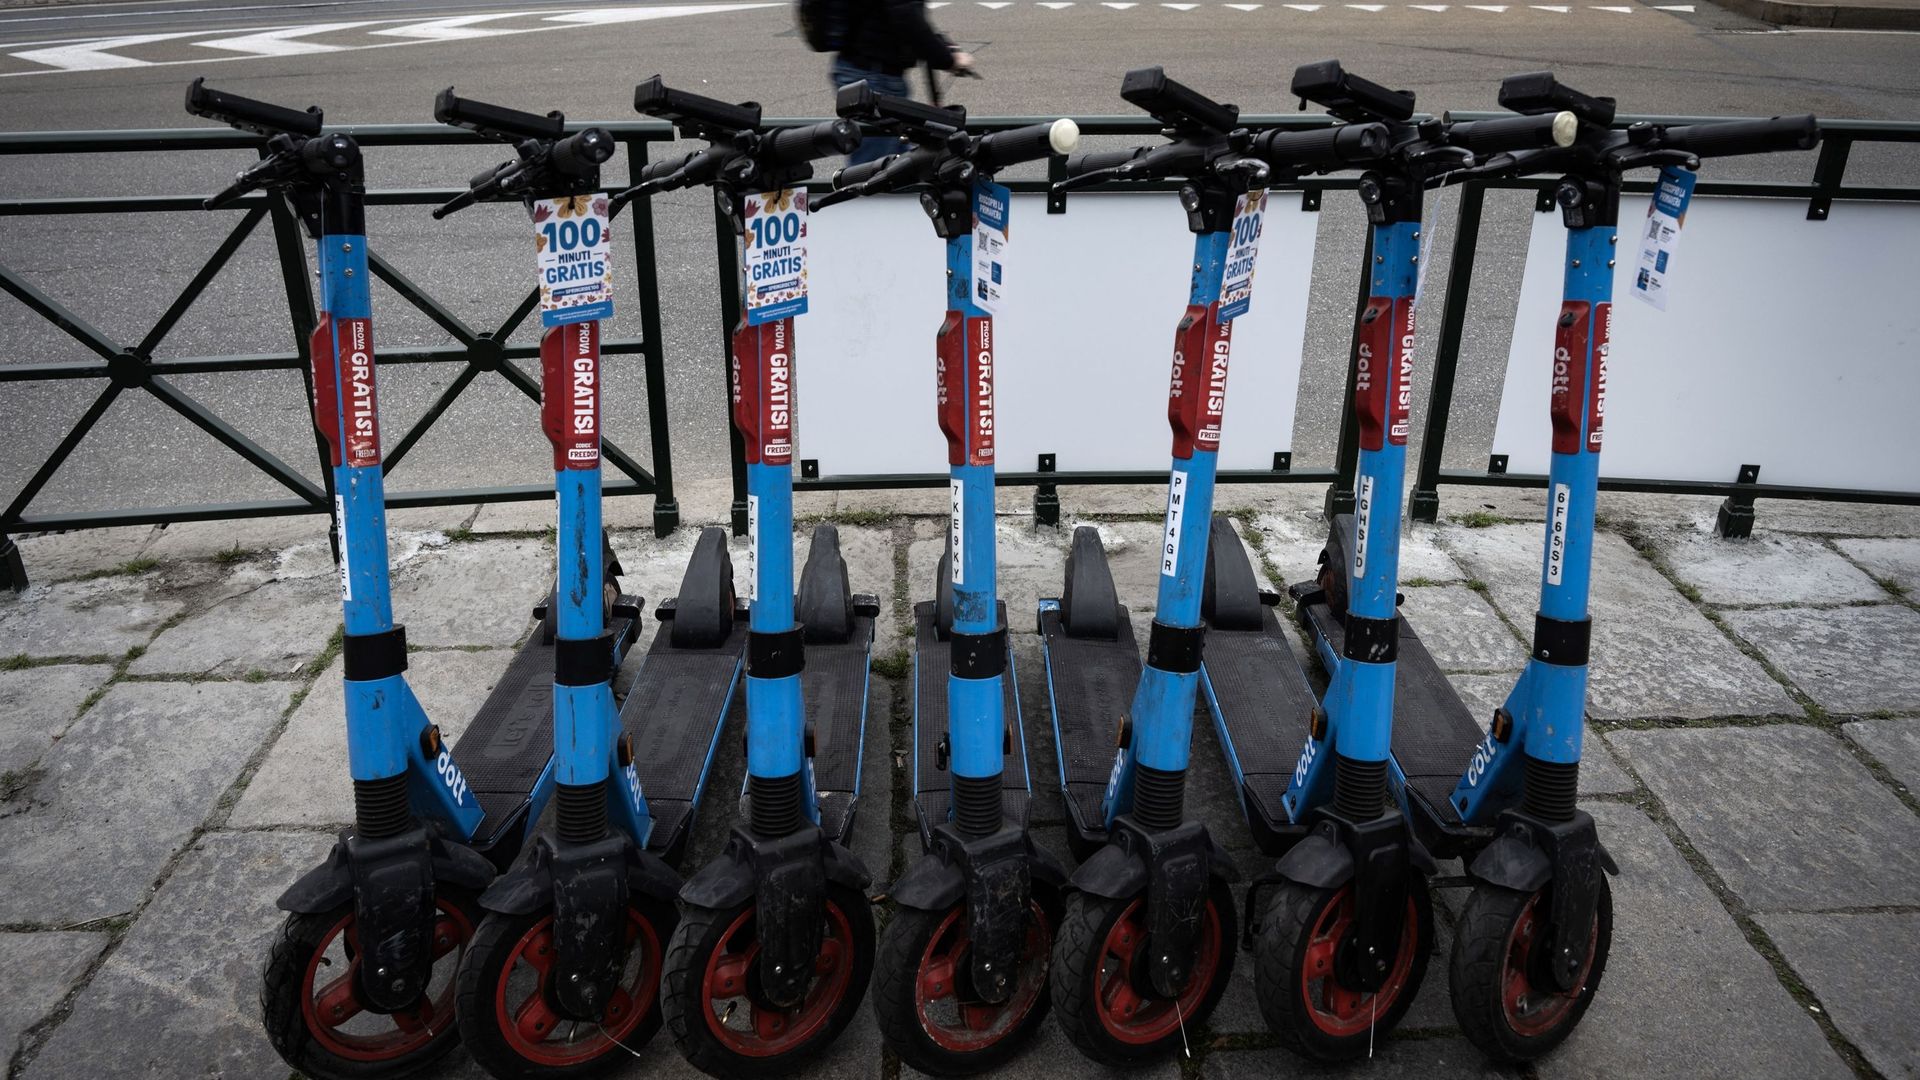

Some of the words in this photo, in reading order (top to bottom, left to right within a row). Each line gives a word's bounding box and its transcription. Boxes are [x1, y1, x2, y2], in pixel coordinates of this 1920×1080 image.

[542, 218, 601, 253] 100
[750, 212, 800, 249] 100
[763, 246, 791, 260] MINUTI
[1233, 213, 1260, 248] 100
[546, 261, 604, 284] GRATIS
[558, 250, 591, 264] MINUTI
[752, 256, 802, 281] GRATIS
[1226, 257, 1254, 280] GRATIS
[356, 322, 365, 350] PROVA
[579, 323, 590, 355] PROVA
[775, 319, 785, 350] PROVA
[1170, 351, 1185, 398] dott
[1207, 340, 1230, 416] GRATIS!
[1357, 343, 1373, 391] dott
[1552, 347, 1571, 395] dott
[351, 352, 373, 437] GRATIS!
[573, 358, 594, 435] GRATIS!
[770, 353, 789, 431] GRATIS!
[978, 351, 993, 436] GRATIS!
[570, 450, 597, 458] FREEDOM
[1165, 477, 1182, 571] PMT4GR
[1356, 485, 1369, 567] FGHSJD
[1551, 493, 1565, 575] 6F65S3
[438, 751, 467, 807] dott
[1295, 734, 1316, 788] dott
